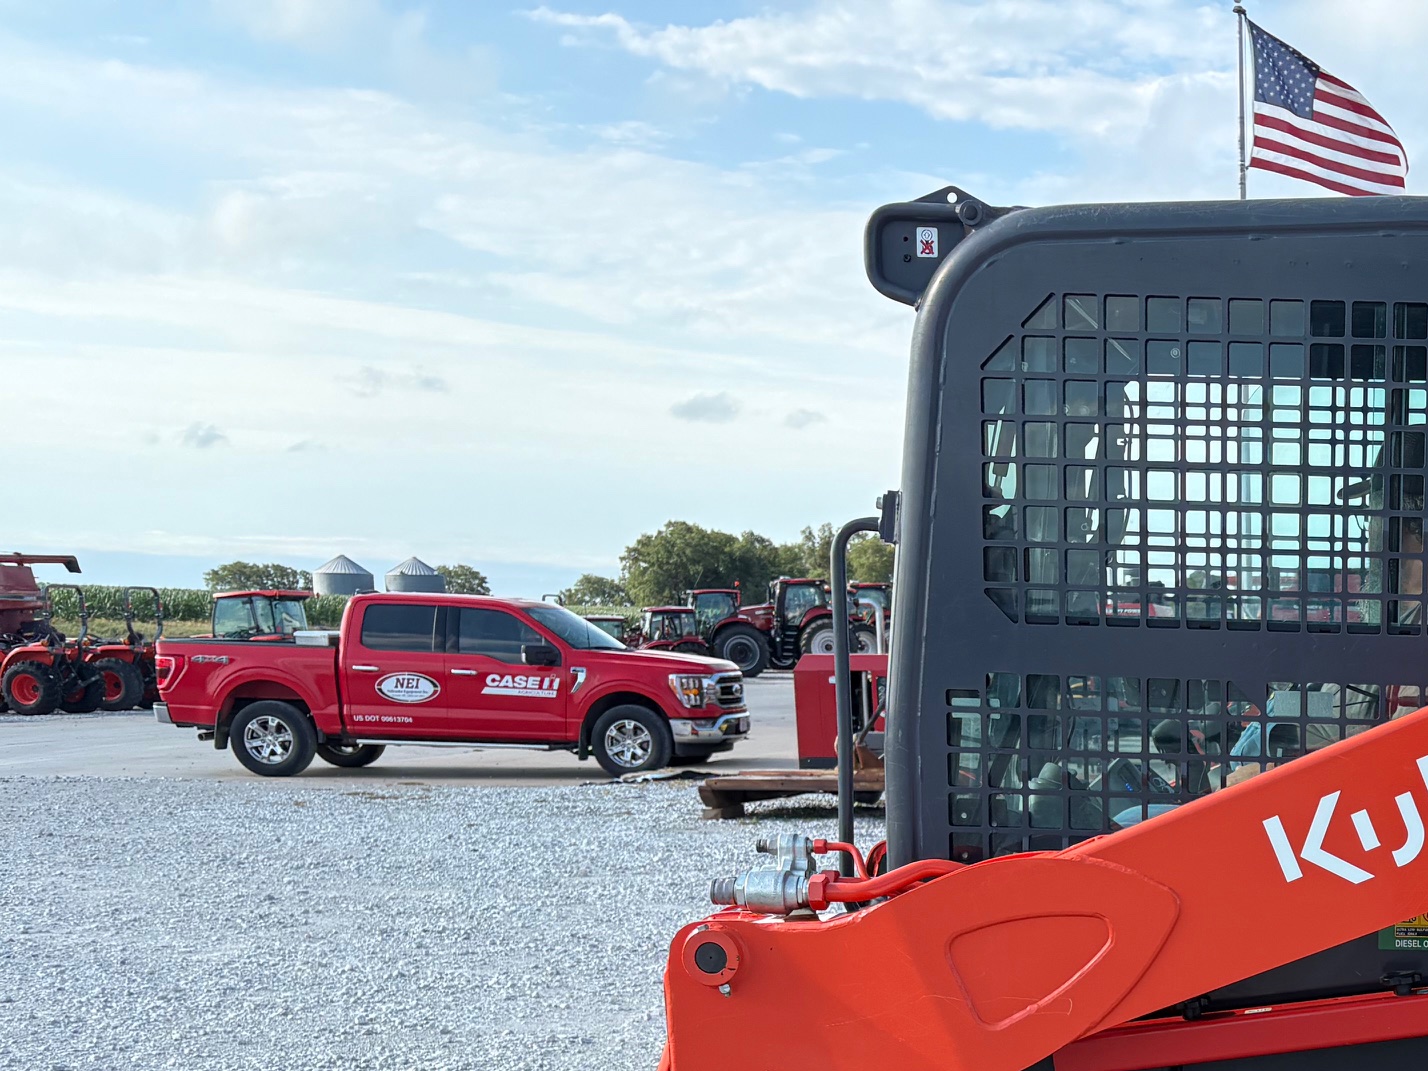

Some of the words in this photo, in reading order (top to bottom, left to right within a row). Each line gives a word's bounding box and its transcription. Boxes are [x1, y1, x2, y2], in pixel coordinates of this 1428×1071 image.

[394, 677, 421, 690] NEI
[485, 673, 541, 689] CASE
[353, 714, 364, 722] US
[365, 714, 379, 722] DOT
[1395, 939, 1421, 948] DIESEL
